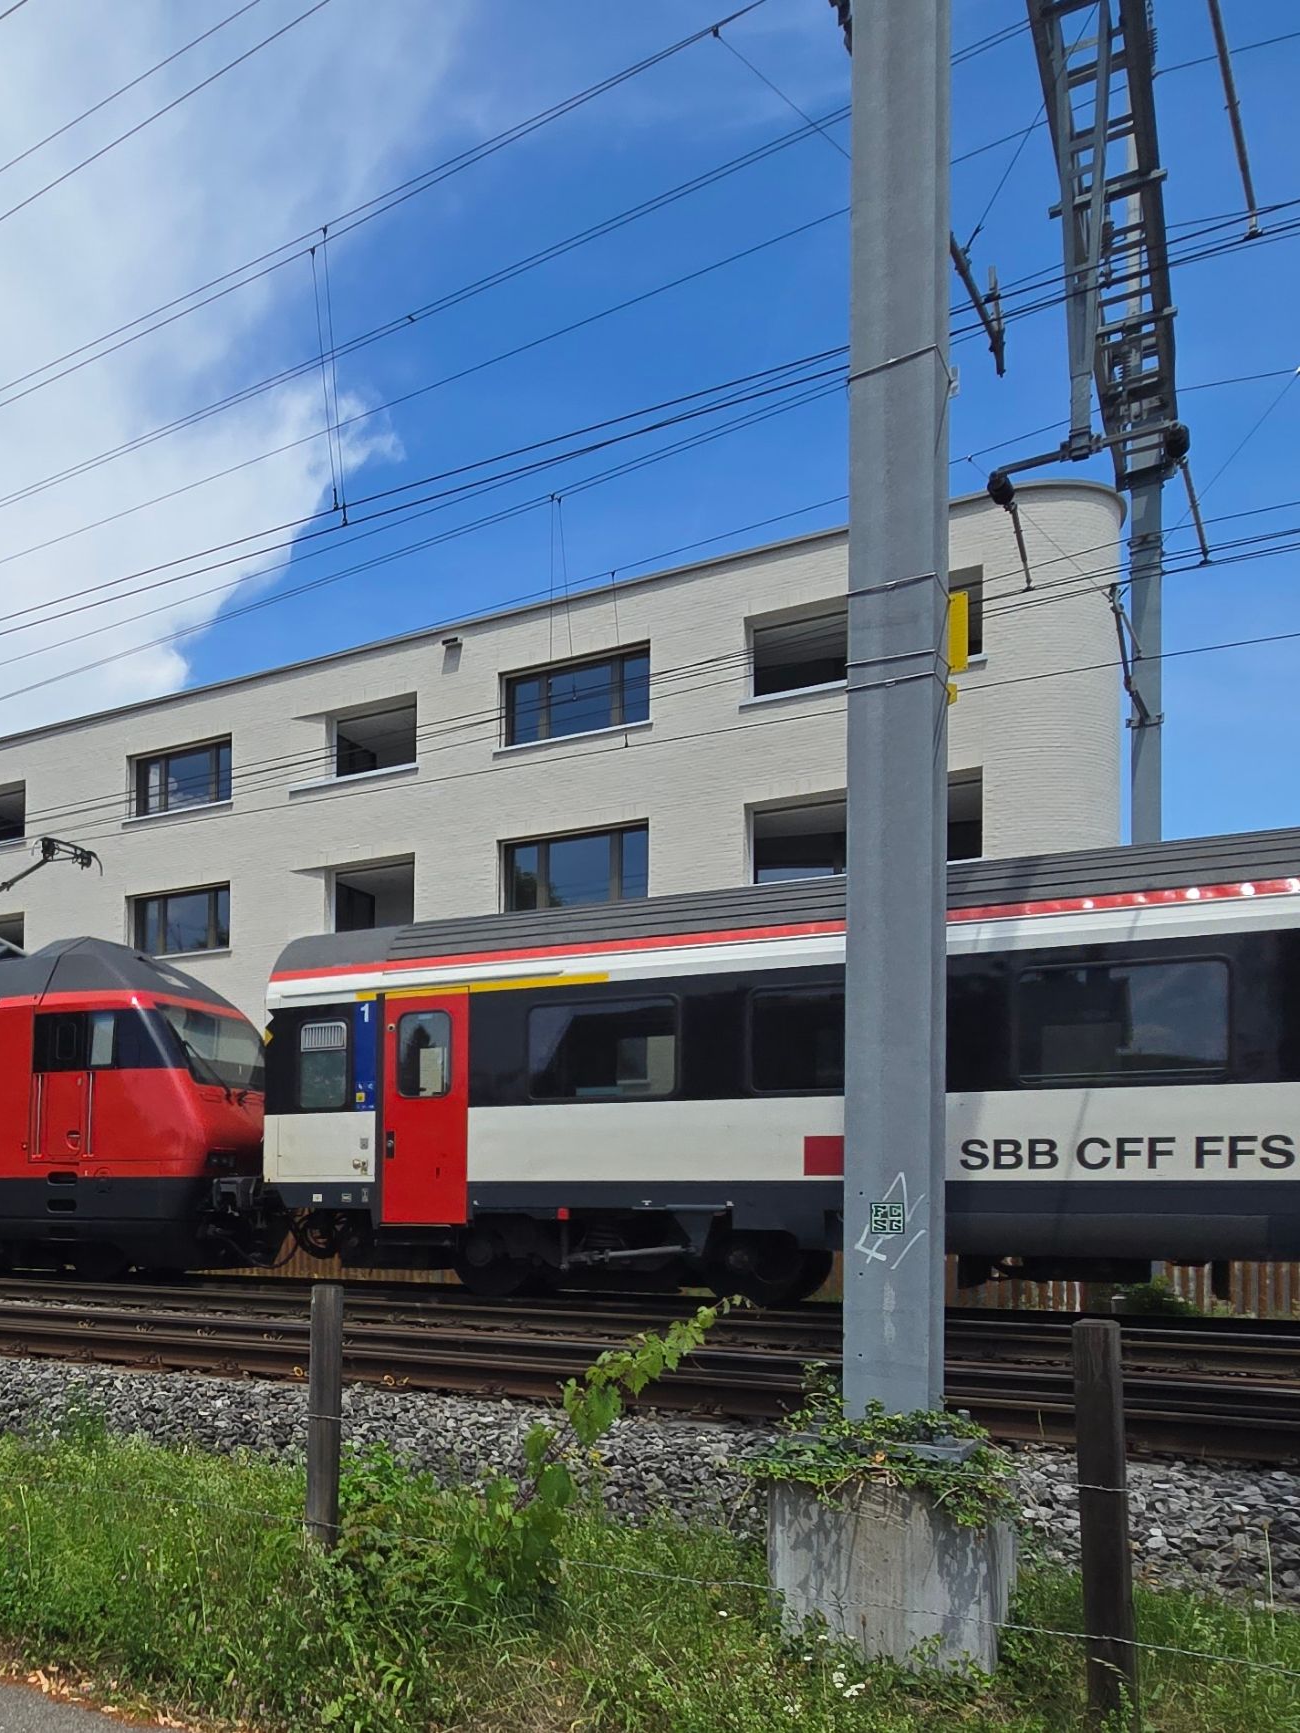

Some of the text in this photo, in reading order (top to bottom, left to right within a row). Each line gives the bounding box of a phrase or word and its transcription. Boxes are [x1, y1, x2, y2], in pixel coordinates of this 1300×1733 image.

[360, 1003, 370, 1023] 1
[959, 1134, 1296, 1171] SBB CFF FFS
